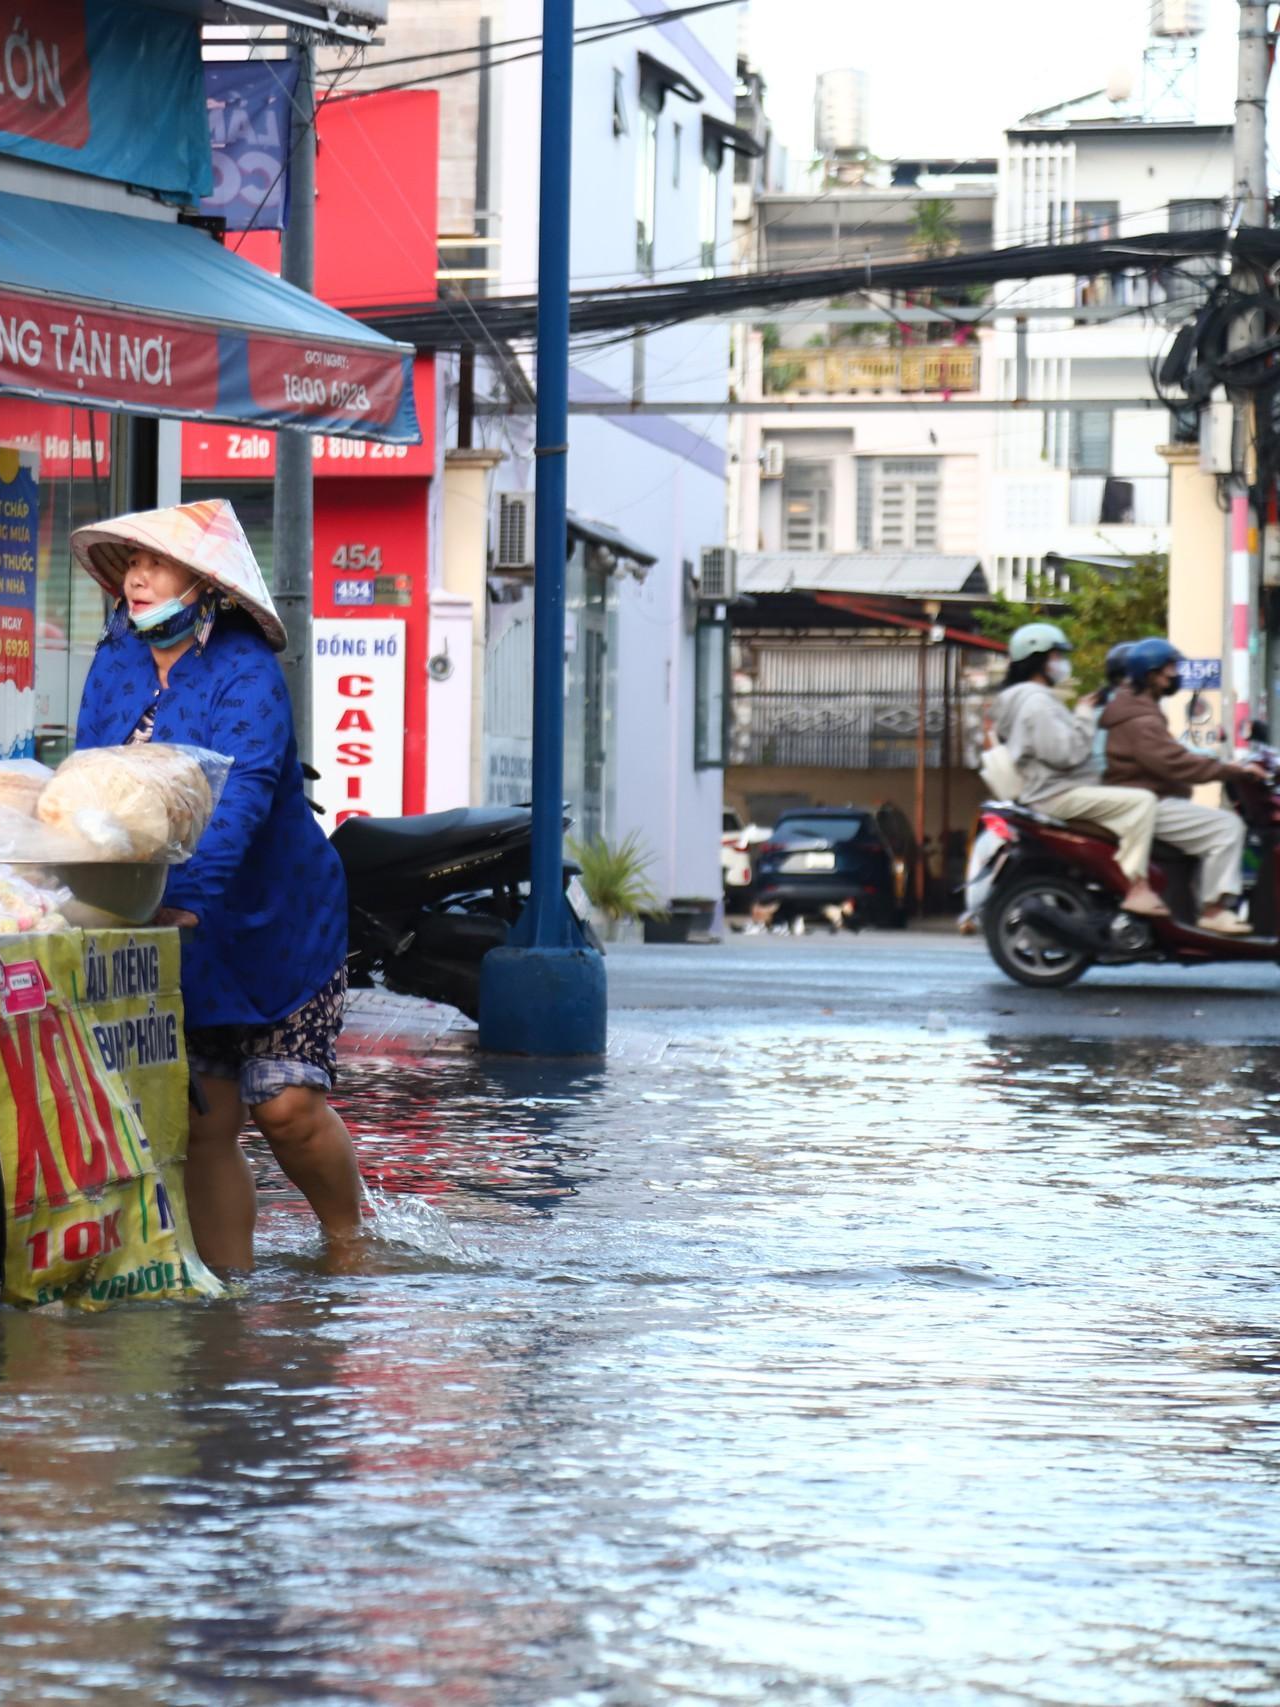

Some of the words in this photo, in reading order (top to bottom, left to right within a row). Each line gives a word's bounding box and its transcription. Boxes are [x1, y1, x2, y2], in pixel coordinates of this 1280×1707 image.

[50, 314, 112, 389] TẬN
[119, 335, 172, 386] NƠI
[283, 373, 326, 406] 1800
[330, 380, 373, 411] 6928
[227, 434, 270, 459] Zalo
[332, 544, 383, 571] 454
[338, 580, 370, 599] 454
[2, 616, 23, 631] NGAY
[5, 637, 30, 659] 6928
[112, 938, 159, 998] RIÊNG
